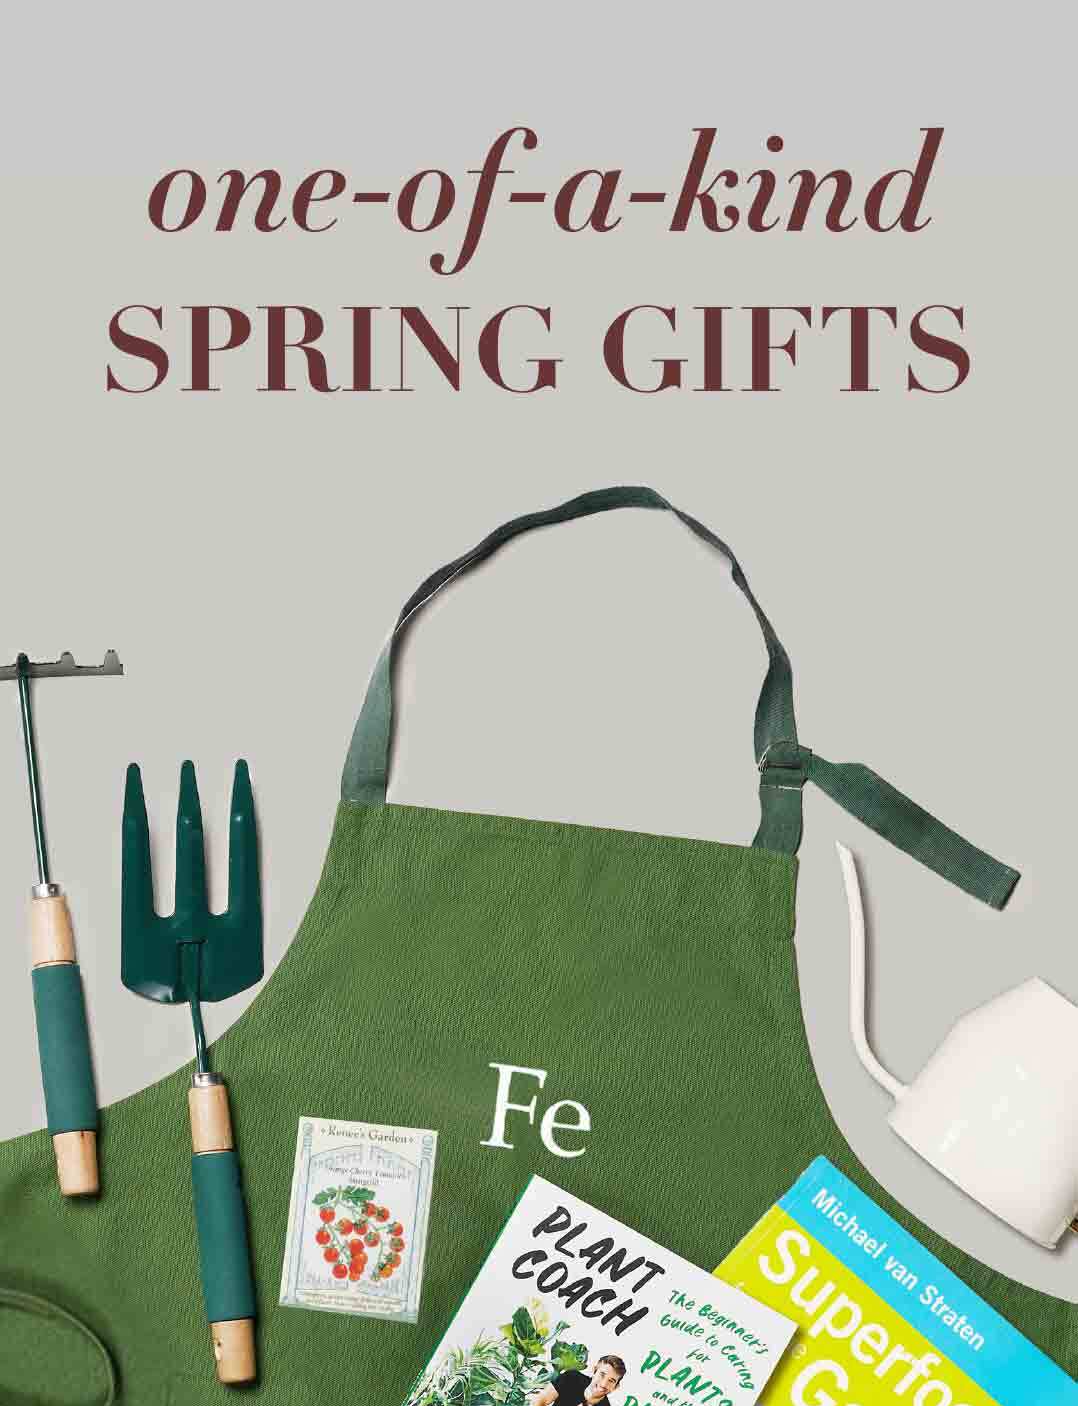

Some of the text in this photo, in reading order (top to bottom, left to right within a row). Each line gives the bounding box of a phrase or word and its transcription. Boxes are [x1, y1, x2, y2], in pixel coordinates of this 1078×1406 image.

[368, 1128, 408, 1144] Garden
[480, 1063, 590, 1157] Fe
[532, 1206, 665, 1294] PLANT
[811, 1187, 985, 1352] Michael van Straten
[512, 1250, 649, 1336] COACH
[668, 1290, 696, 1311] The
[698, 1303, 769, 1355] Beginner's
[659, 1313, 705, 1338] Guide
[705, 1334, 720, 1347] to
[721, 1345, 755, 1390] Caring
[686, 1348, 712, 1364] for
[652, 1391, 677, 1406] and
